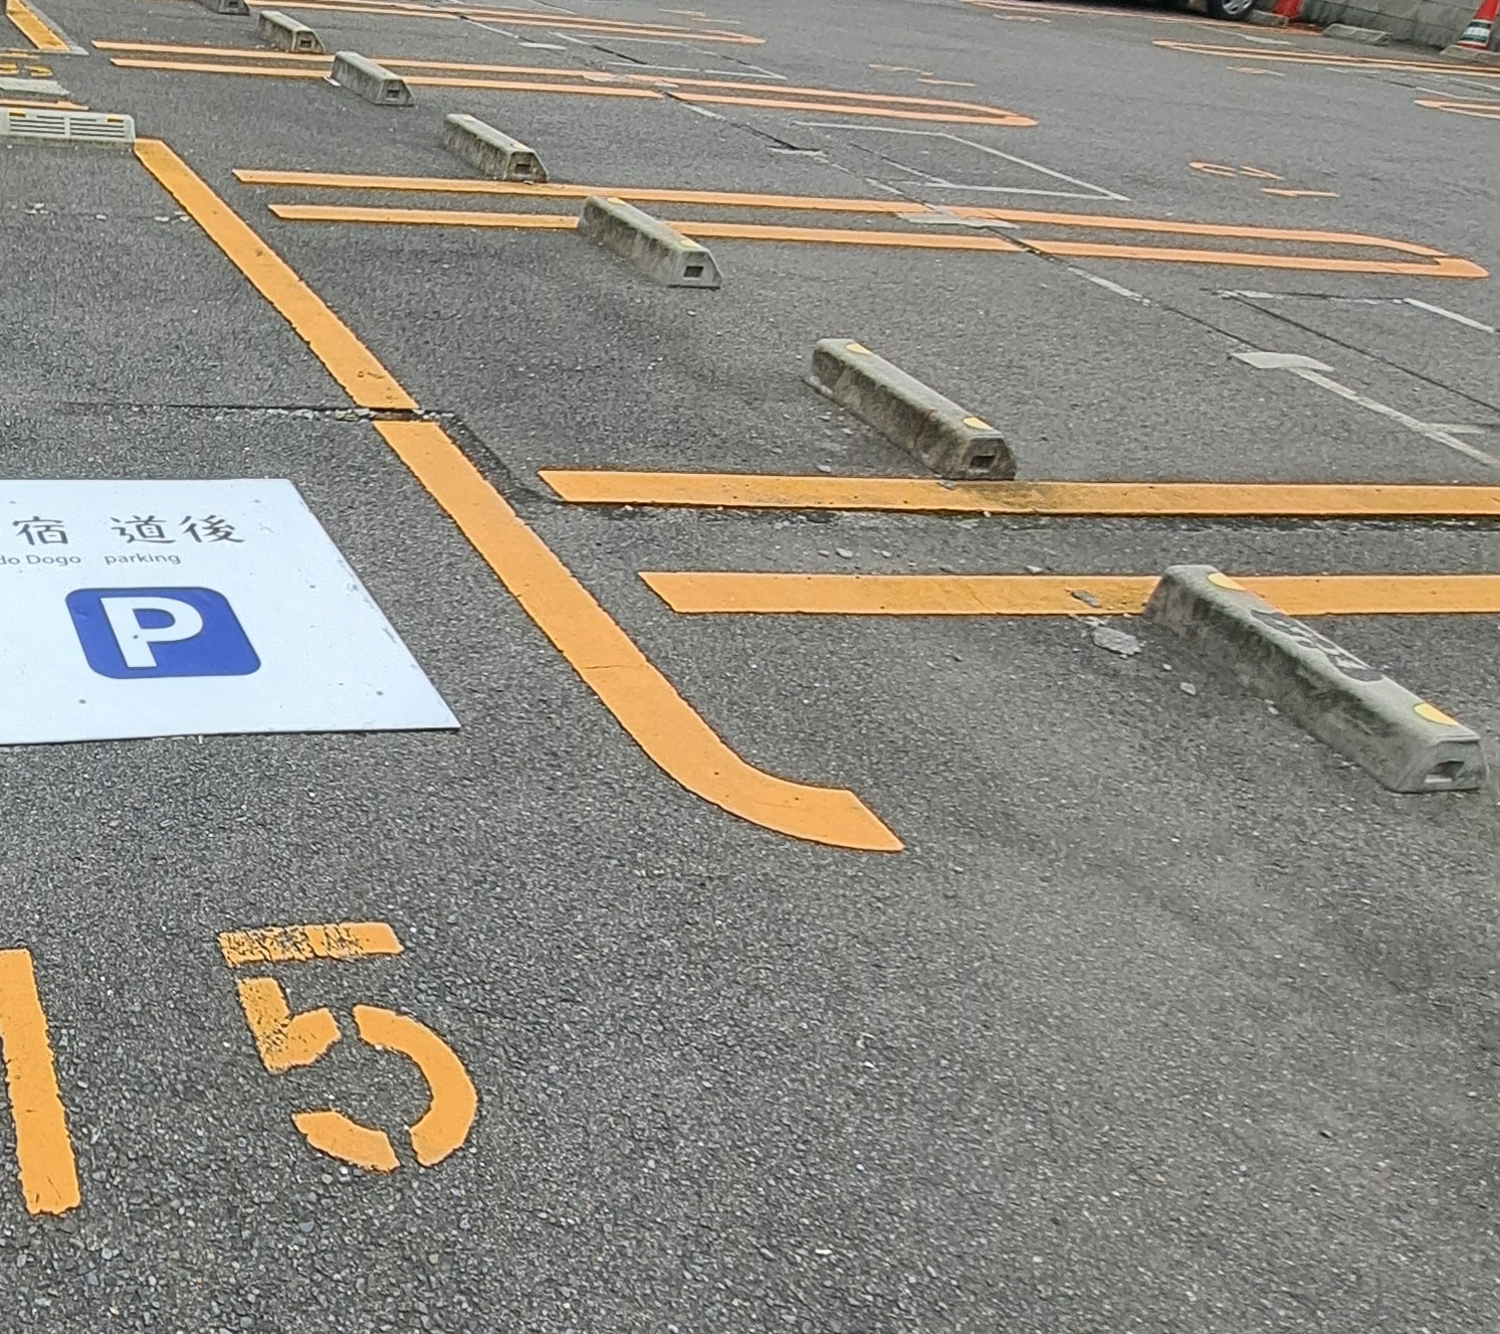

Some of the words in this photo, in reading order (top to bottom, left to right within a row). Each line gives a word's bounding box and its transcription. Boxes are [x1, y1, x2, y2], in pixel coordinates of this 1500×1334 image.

[109, 515, 246, 544] 道後
[26, 554, 82, 568] Dogo
[104, 552, 182, 566] parking
[100, 596, 204, 669] P
